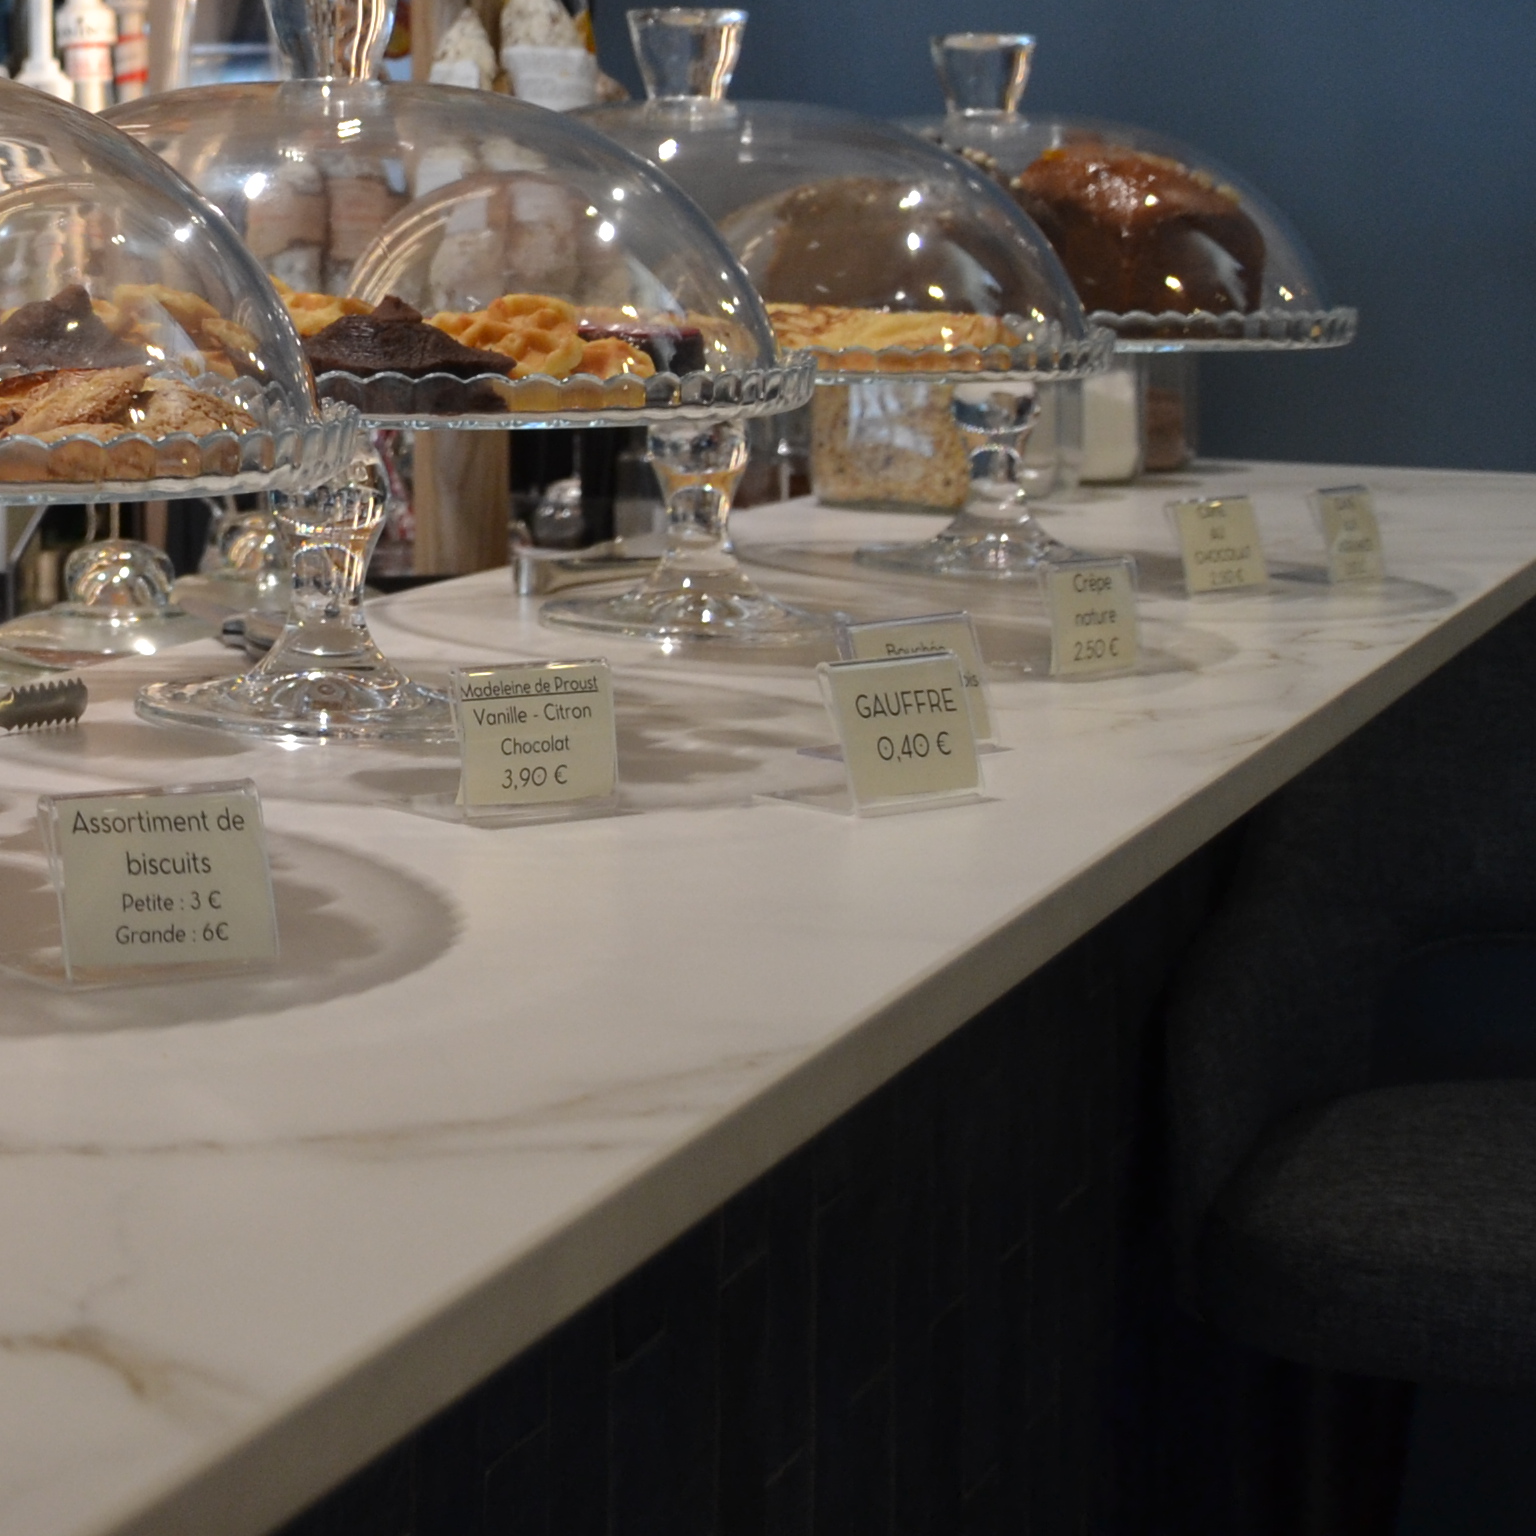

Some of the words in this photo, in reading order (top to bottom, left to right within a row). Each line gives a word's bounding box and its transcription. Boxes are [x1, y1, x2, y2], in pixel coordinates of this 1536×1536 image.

[461, 681, 532, 699] Madeleine
[535, 677, 551, 693] de
[554, 675, 599, 692] Proust
[473, 706, 528, 726] Vanille
[543, 703, 592, 721] Citron
[855, 687, 958, 719] GAUFFRE
[500, 735, 570, 756] Chocolat
[877, 732, 930, 763] 0,40
[936, 731, 952, 756] €
[501, 766, 548, 791] 3,90
[554, 764, 569, 785] €
[72, 810, 211, 835] Assortiment
[216, 807, 246, 832] de
[125, 851, 212, 876] biscuits
[122, 892, 175, 913] Petite
[190, 891, 201, 910] 3
[208, 890, 223, 910] €
[115, 925, 187, 945] Grande
[202, 922, 230, 943] 6€
